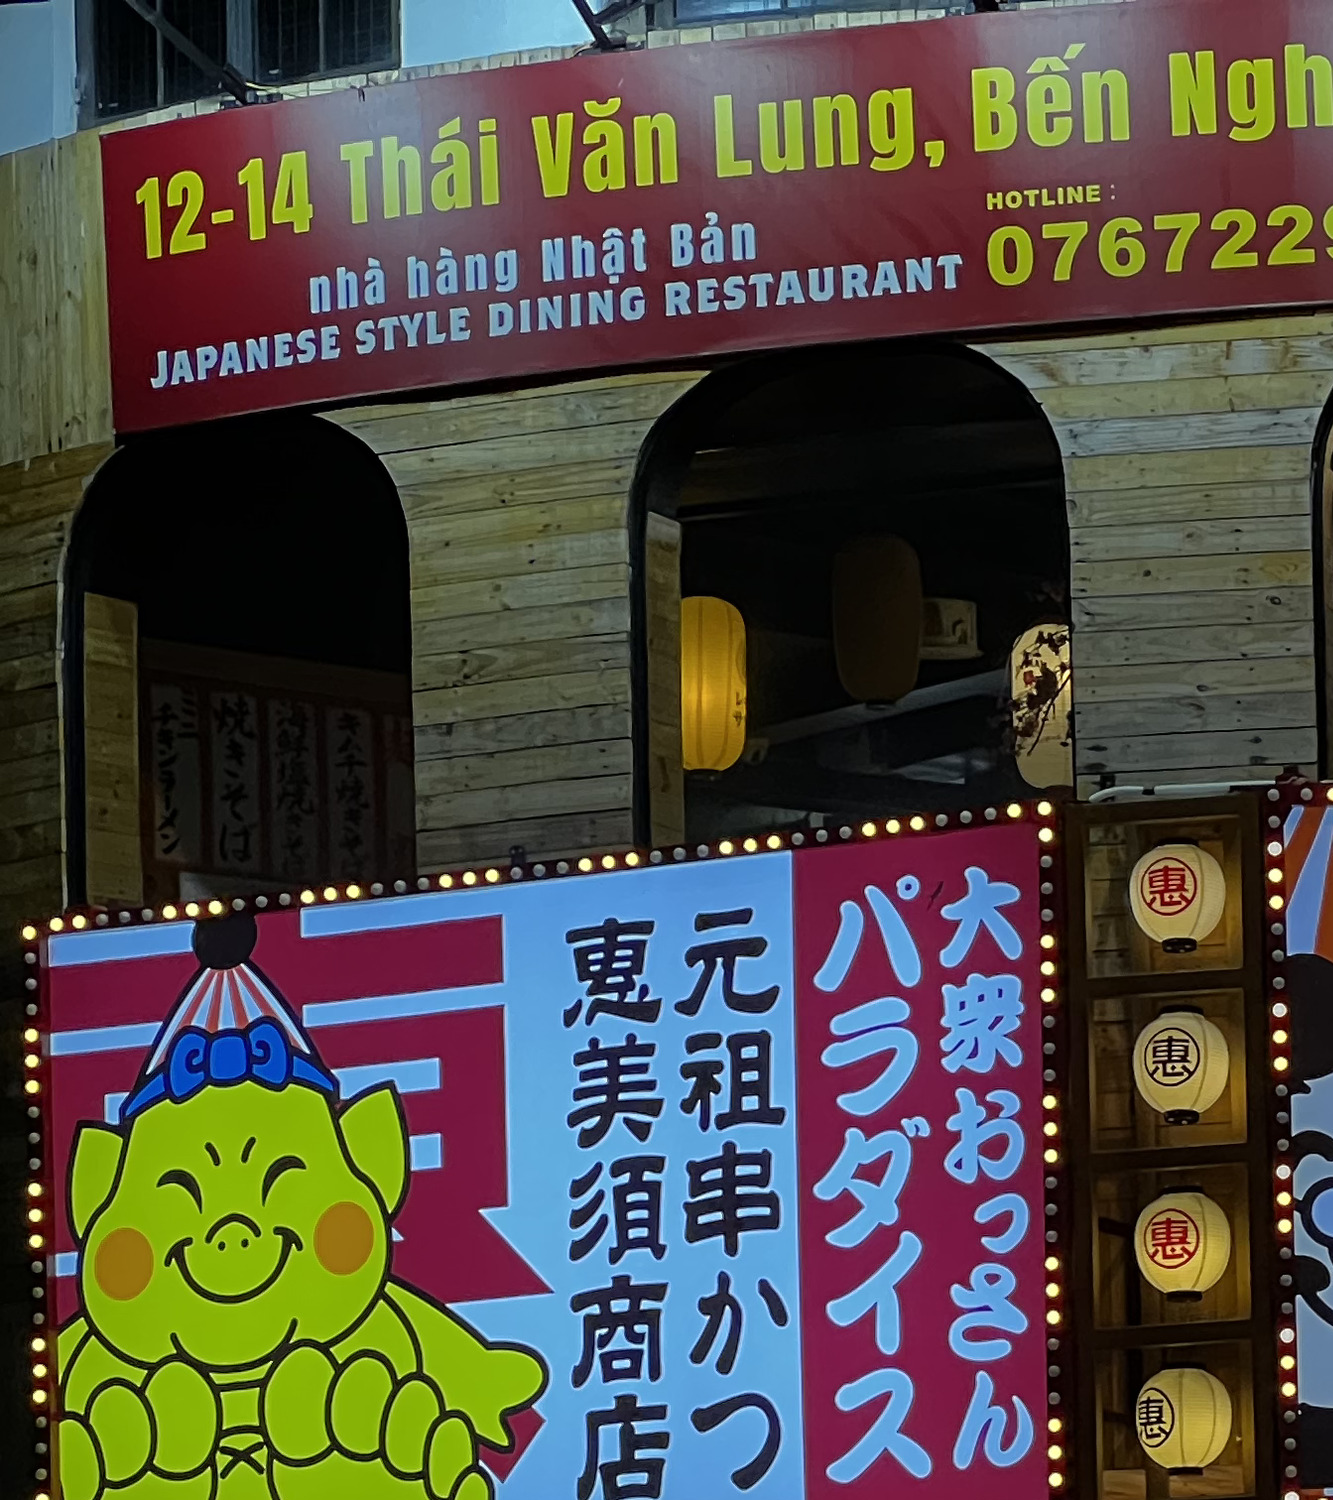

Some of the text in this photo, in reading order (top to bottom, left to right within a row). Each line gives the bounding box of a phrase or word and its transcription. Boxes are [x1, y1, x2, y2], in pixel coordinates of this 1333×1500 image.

[135, 150, 314, 260] 12-14
[339, 117, 500, 224] Thái
[531, 97, 679, 198] Văn
[714, 87, 945, 180] Lung,
[971, 42, 1130, 152] Bến
[150, 253, 963, 390] JAPANESE STYLE DINING RESTAURANT
[310, 212, 757, 314] nhà hàng Nhật Bản
[674, 907, 788, 1492] 元祖串かつ
[812, 873, 933, 1484] パラダイス
[938, 865, 1036, 1471] 大衆おっさん
